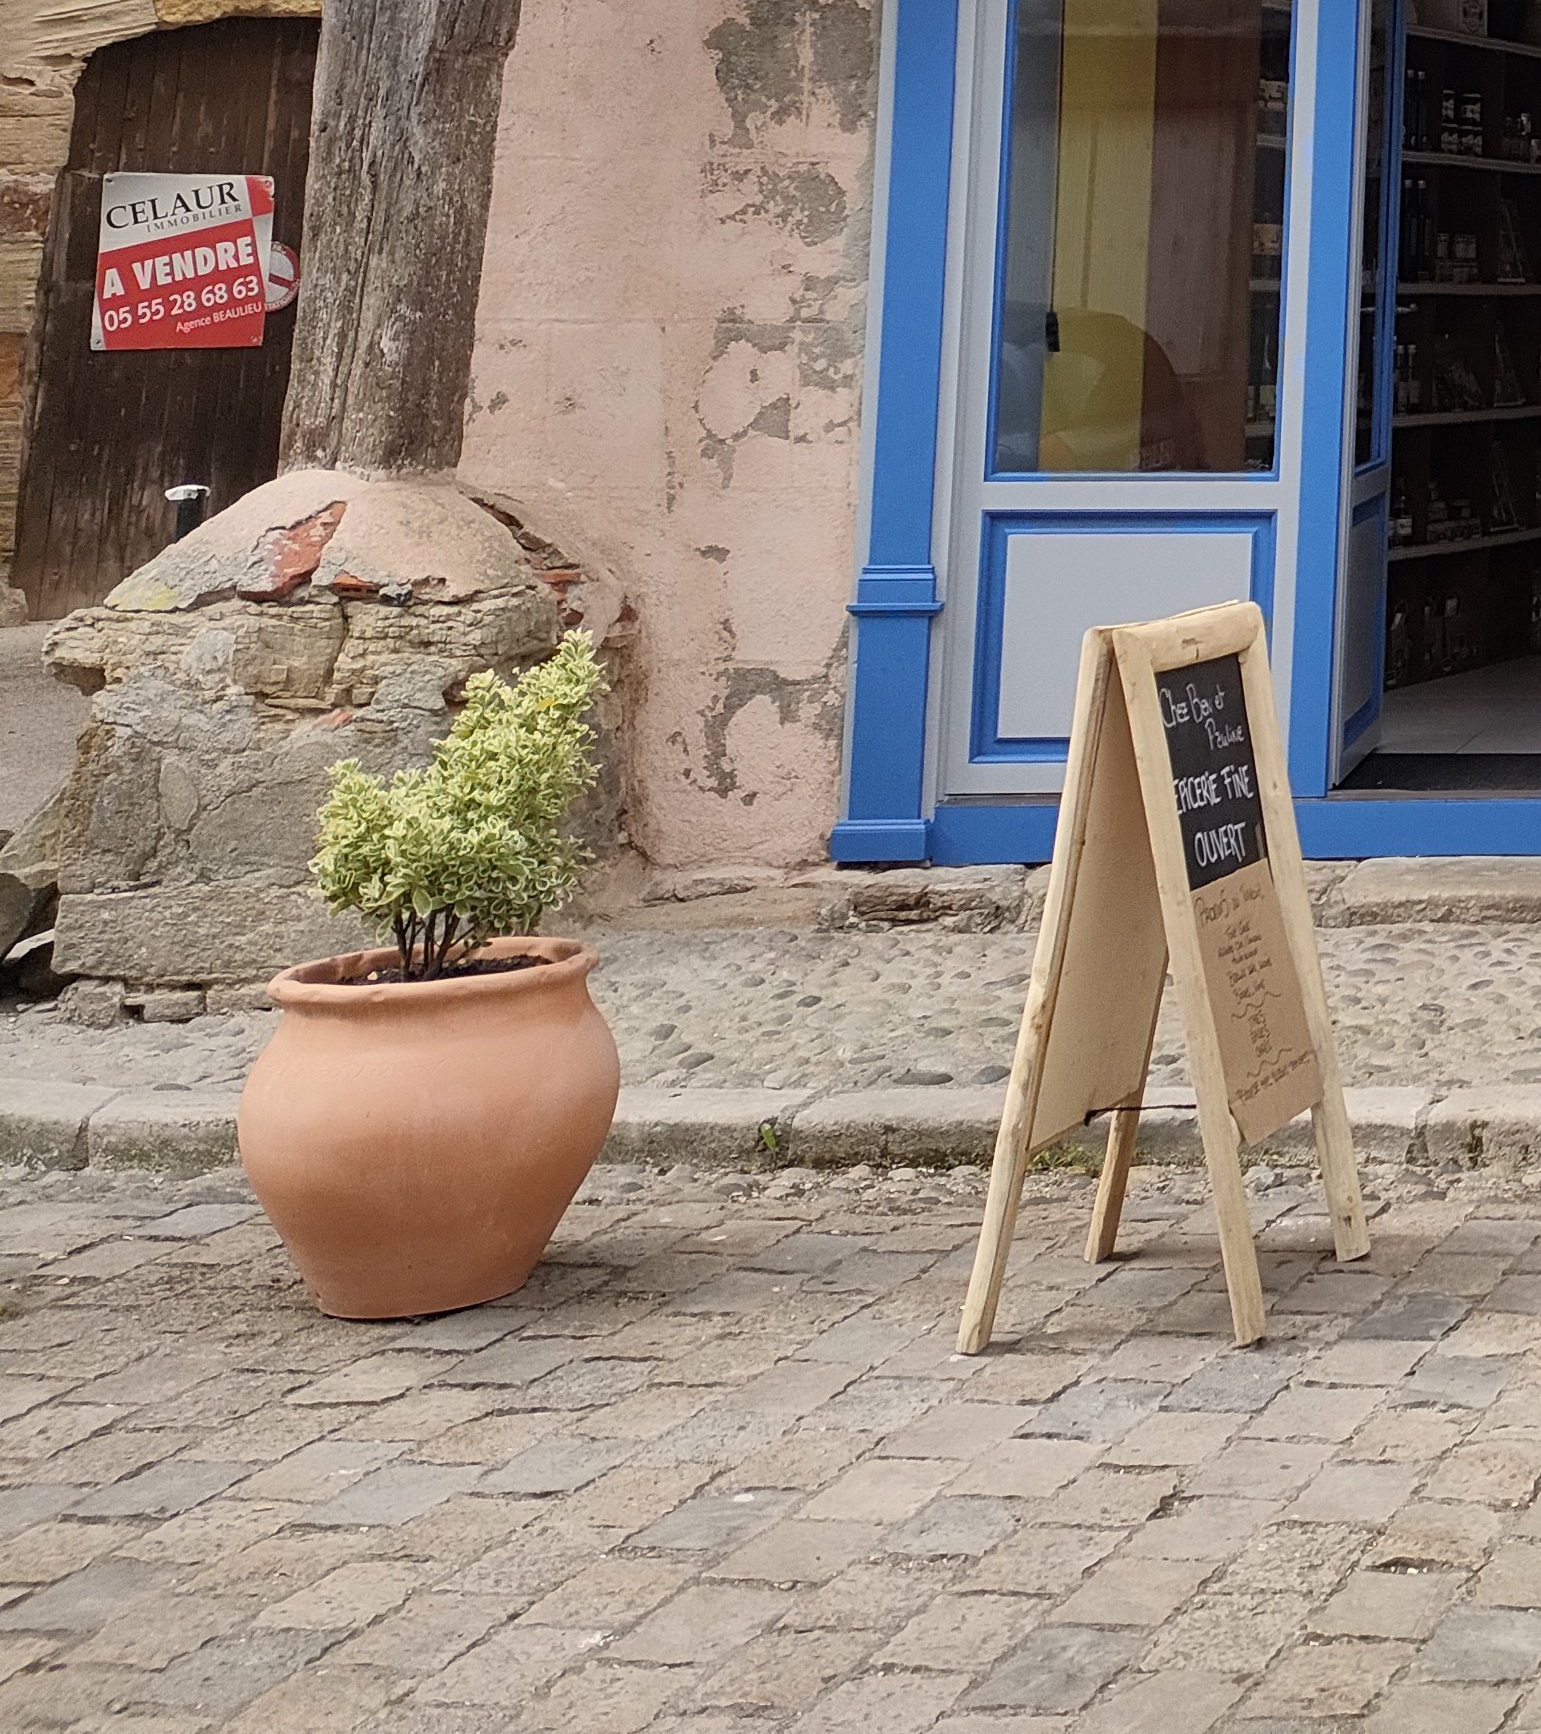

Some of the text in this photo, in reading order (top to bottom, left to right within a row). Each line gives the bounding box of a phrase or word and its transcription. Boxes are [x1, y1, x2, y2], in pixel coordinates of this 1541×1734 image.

[106, 181, 240, 229] CELAUR
[146, 203, 243, 233] IMMOBILIER
[103, 236, 255, 300] A VENDRE
[104, 275, 260, 332] 05 55 28 68 63
[175, 301, 262, 334] Agence BEAULIEU
[1194, 821, 1246, 867] OUVERT
